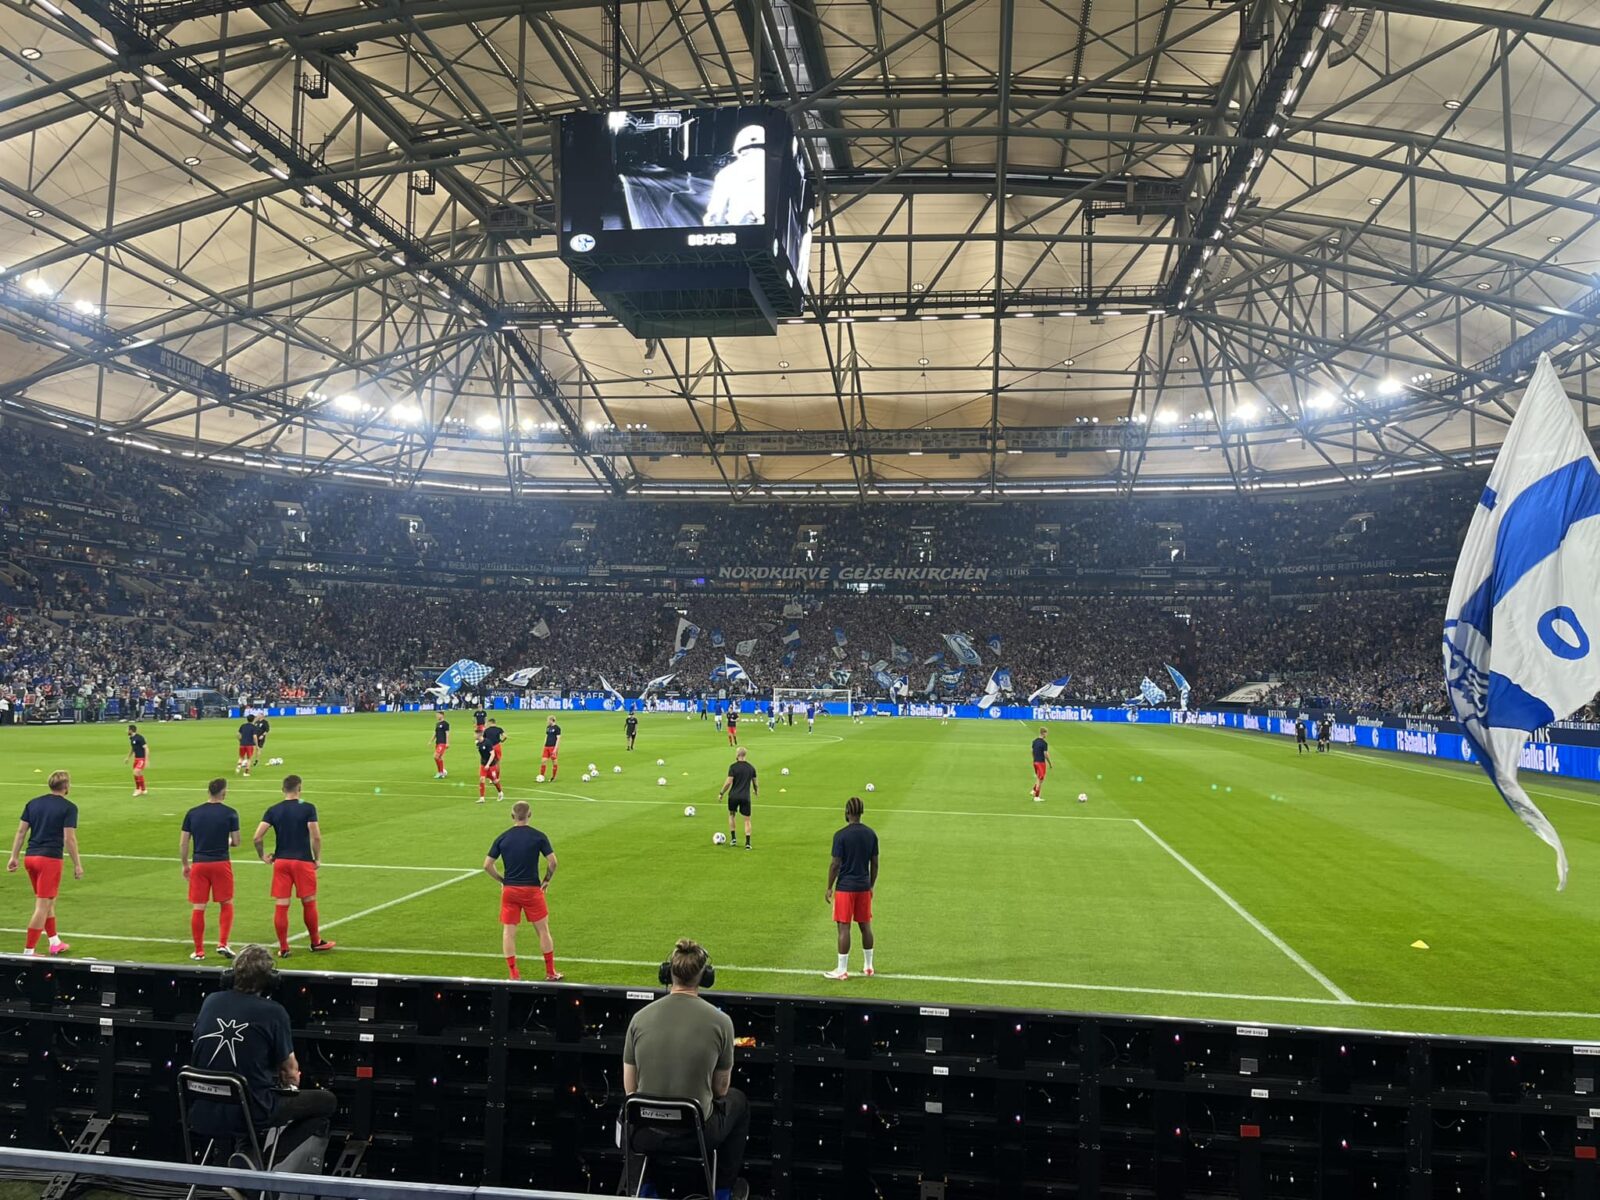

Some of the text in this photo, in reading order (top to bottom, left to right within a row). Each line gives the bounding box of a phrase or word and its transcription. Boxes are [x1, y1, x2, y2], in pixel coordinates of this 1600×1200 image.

[718, 566, 830, 580] NORDKURVE
[838, 566, 989, 581] GELSENKIRCHEN
[1081, 709, 1093, 720] 04
[1397, 731, 1437, 755] FC Schalke 04
[1545, 745, 1560, 772] 04
